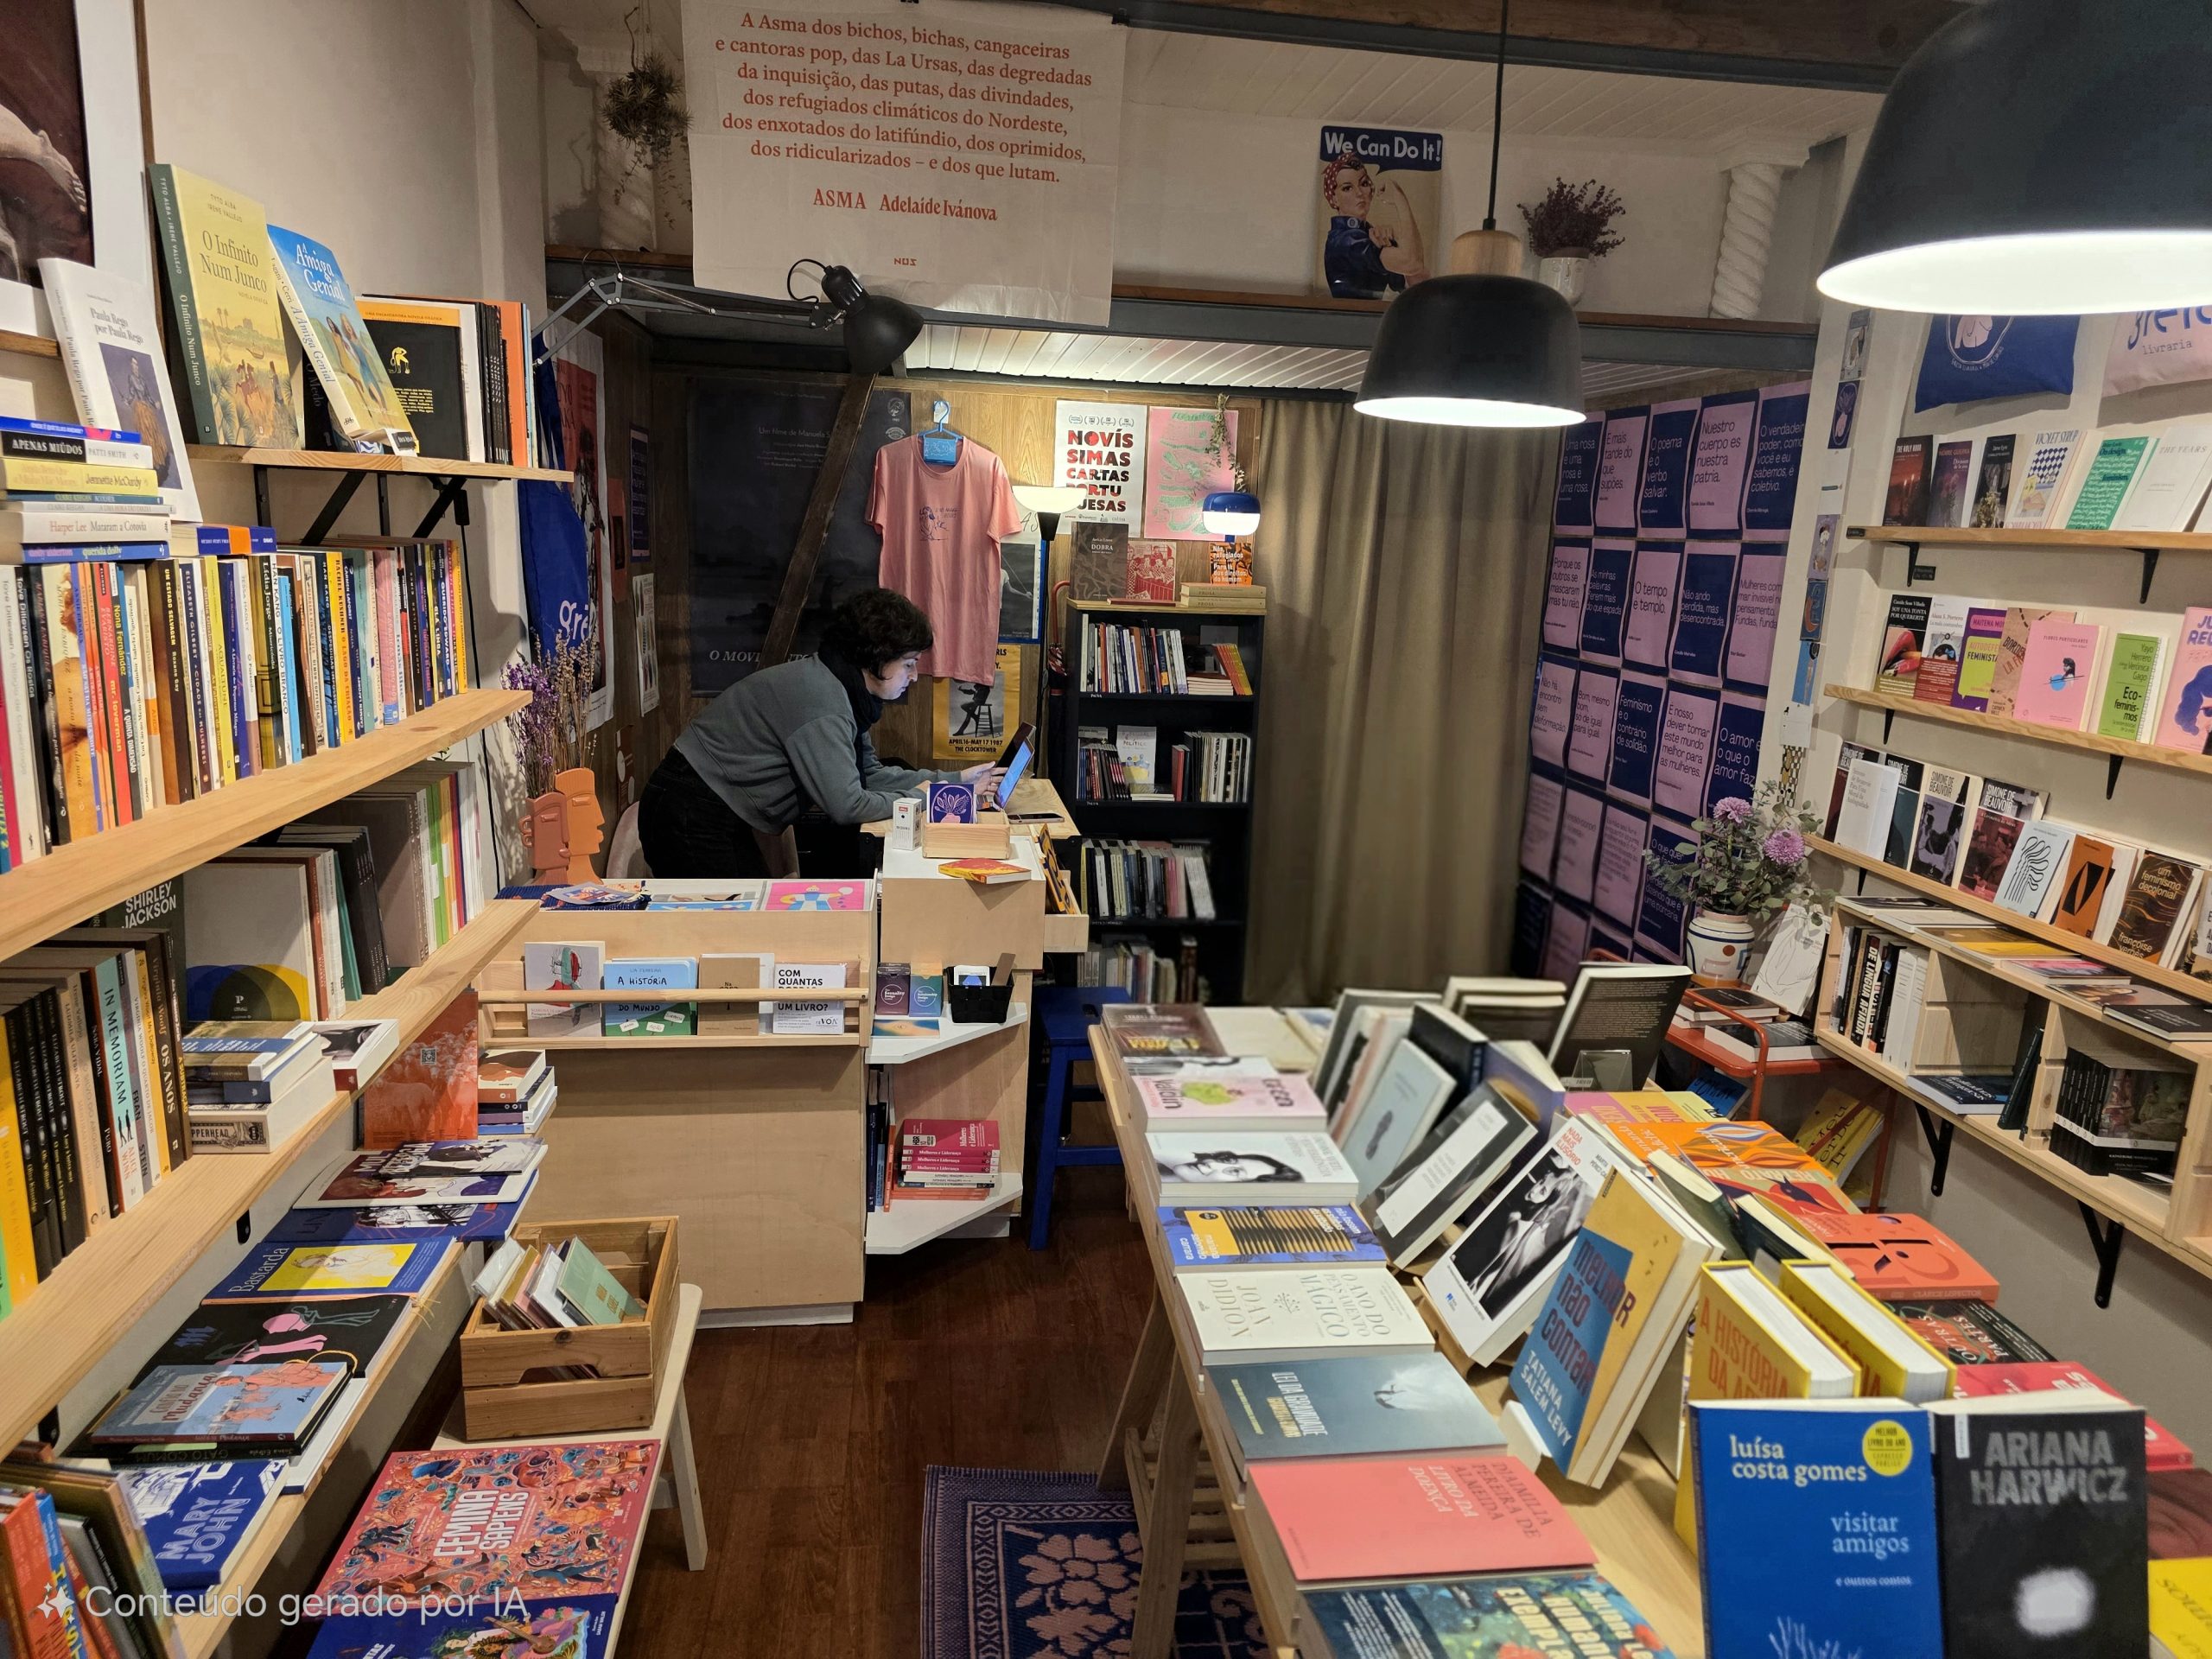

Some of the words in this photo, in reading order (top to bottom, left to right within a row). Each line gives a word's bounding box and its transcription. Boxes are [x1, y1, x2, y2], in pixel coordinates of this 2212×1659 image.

[741, 12, 754, 28] A
[759, 15, 807, 33] Asma
[812, 19, 842, 35] dos
[847, 22, 906, 45] bichos,
[912, 27, 969, 52] bichas,
[975, 40, 1069, 59] cangaceiras
[715, 40, 724, 51] e
[730, 41, 804, 57] cantoras
[810, 48, 847, 66] pop,
[852, 48, 880, 64] das
[886, 51, 906, 67] La
[912, 54, 962, 76] Ursas,
[968, 60, 994, 76] das
[1000, 63, 1091, 86] degredadas
[738, 62, 759, 79] da
[763, 65, 855, 91] inquisição,
[861, 73, 888, 91] das
[893, 81, 944, 99] putas,
[949, 82, 976, 99] das
[981, 86, 1073, 112] divindades,
[744, 89, 773, 105] dos
[779, 92, 868, 115] refugiados
[873, 101, 957, 123] climáticos
[963, 109, 983, 125] do
[988, 112, 1067, 137] Nordeste,
[723, 113, 752, 130] dos
[758, 119, 844, 137] enxotados
[850, 124, 870, 139] do
[876, 125, 961, 151] latifúndio,
[966, 135, 994, 151] dos
[1000, 140, 1085, 164] oprimidos,
[1325, 132, 1353, 154] We
[1357, 135, 1389, 156] Can
[1394, 137, 1419, 159] Do
[1423, 139, 1443, 162] It!
[751, 140, 780, 156] dos
[785, 143, 910, 168] ridicularizados
[929, 159, 938, 169] e
[943, 156, 970, 173] dos
[976, 164, 1004, 180] que
[1009, 163, 1059, 182] lutam.
[813, 188, 867, 209] ASMA
[943, 200, 997, 220] Ivánova
[202, 230, 213, 251] O
[214, 234, 258, 267] Infinito
[200, 252, 232, 282] Num
[235, 264, 267, 293] Junco
[296, 244, 334, 283] Amiga
[304, 270, 346, 302] Genial
[90, 308, 111, 323] Paula
[112, 314, 129, 327] Rego
[181, 304, 192, 335] Infinito
[95, 325, 109, 335] por
[109, 325, 128, 340] Paula
[187, 337, 196, 360] Num
[2143, 339, 2193, 356] livraria
[191, 359, 200, 385] Junco
[1702, 420, 1735, 434] Nuestro
[12, 439, 48, 454] APENAS
[49, 440, 83, 455] MIÚDOS
[88, 448, 107, 456] PATTI
[107, 449, 126, 458] SMITH
[1067, 429, 1134, 448] NOVÍS
[1699, 439, 1728, 453] cuerpo
[1730, 437, 1741, 448] es
[1066, 449, 1130, 467] SIMAS
[2160, 446, 2177, 454] THE
[2178, 445, 2207, 454] YEARS
[1696, 454, 1728, 467] nuestra
[1066, 467, 1129, 482] CARTAS
[1694, 470, 1720, 486] patria.
[50, 520, 74, 536] Harper
[75, 520, 86, 532] Lee
[90, 521, 118, 532] Mataram
[124, 520, 147, 531] Cotovia
[165, 569, 170, 580] UM
[1635, 581, 1642, 594] O
[1643, 582, 1668, 600] tempo
[1640, 600, 1666, 615] templo.
[1619, 695, 1652, 713] Feminismo
[2122, 686, 2142, 701] Eco-
[1675, 708, 1694, 721] nosso
[2113, 698, 2139, 712] feminis-
[1666, 719, 1686, 731] dever
[2124, 712, 2138, 722] mos
[1664, 733, 1680, 743] este
[1680, 736, 1704, 751] mundo
[1719, 728, 1728, 742] O
[1730, 734, 1754, 748] amor
[1662, 743, 1685, 759] melhor
[1686, 751, 1702, 765] para
[1659, 757, 1669, 766] as
[1669, 760, 1700, 778] mulheres.
[1714, 764, 1738, 779] amor
[1986, 783, 2006, 800] SIMONE
[2008, 790, 2016, 802] DE
[1984, 794, 2013, 813] BEAUVOIR
[2141, 871, 2181, 891] feminismo
[2158, 868, 2171, 876] um
[126, 881, 172, 912] SHIRLEY
[2138, 881, 2177, 899] decolonial
[121, 894, 176, 928] JACKSON
[2118, 931, 2153, 952] françoise
[1867, 946, 1878, 961] DE
[617, 976, 624, 985] A
[778, 978, 823, 987] QUANTAS
[779, 969, 801, 978] COM
[105, 988, 114, 1006] IN
[795, 1002, 829, 1011] LIVRO?
[1856, 998, 1870, 1035] AFIADA
[107, 1011, 127, 1104] MEMORIAM
[161, 1044, 171, 1068] OS
[162, 1070, 175, 1115] ANOS
[228, 1247, 290, 1293] Bastarda
[1207, 1279, 1253, 1338] DIDION
[1236, 1285, 1274, 1325] JOAN
[1527, 1350, 1563, 1411] TATIANA
[1521, 1363, 1548, 1410] SALEM
[1547, 1407, 1573, 1446] LEVY
[1730, 1434, 1785, 1459] luísa
[1984, 1429, 2114, 1467] ARIANA
[1732, 1462, 1789, 1480] costa
[1794, 1464, 1867, 1488] gomes
[1970, 1465, 2129, 1507] HARWICZ
[156, 1497, 221, 1560] MARY
[185, 1497, 251, 1565] JOHN
[433, 1490, 499, 1557] FEMINA
[479, 1491, 529, 1550] SAPIENS
[1830, 1510, 1899, 1533] visitar
[1832, 1533, 1910, 1560] amigos
[1835, 1578, 1842, 1586] e
[1844, 1577, 1877, 1586] outros
[1878, 1576, 1912, 1586] contos
